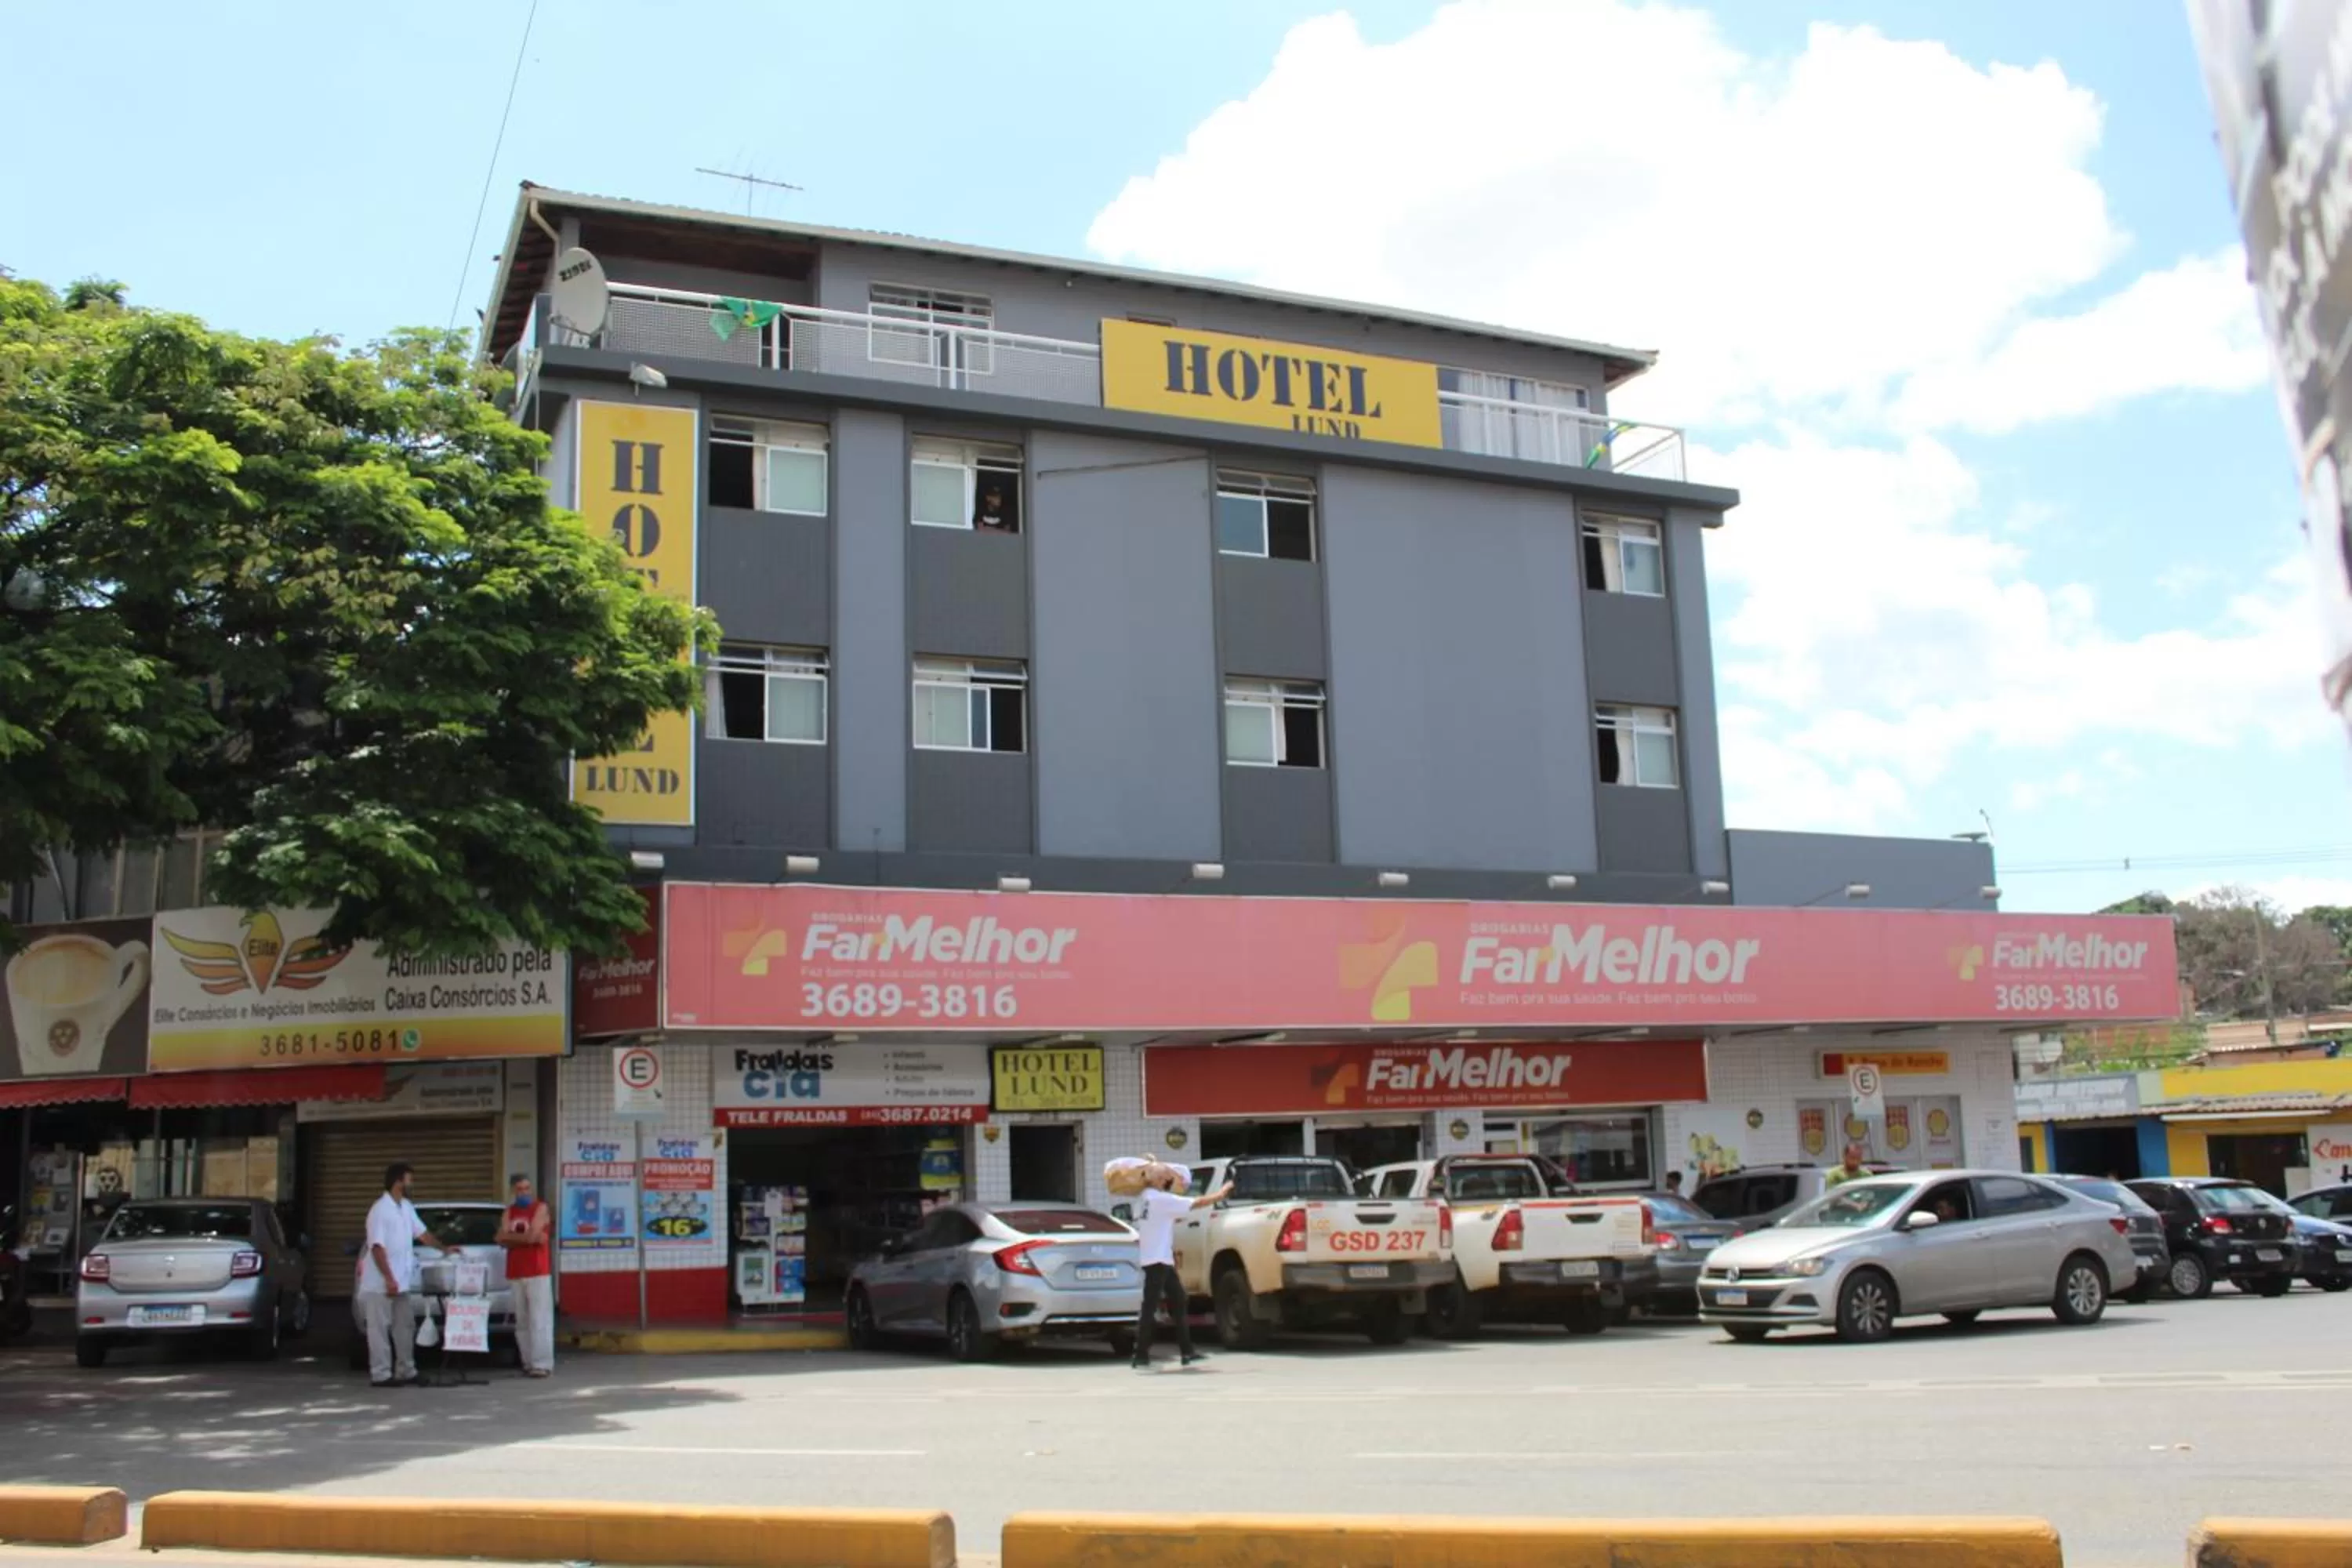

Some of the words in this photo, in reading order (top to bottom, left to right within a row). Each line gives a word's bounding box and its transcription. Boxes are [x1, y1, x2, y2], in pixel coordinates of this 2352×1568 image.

[1163, 340, 1381, 418] HOTEL
[1293, 414, 1360, 439] LUND
[586, 765, 679, 794] LUND
[801, 914, 1077, 964] FarMelhor
[1470, 923, 1549, 935] DROGARIAS
[249, 938, 277, 956] Elite
[1460, 924, 1759, 985] FarMelhor
[1992, 932, 2148, 969] FarMelhor
[387, 946, 507, 978] Administrado
[512, 946, 553, 978] pela
[385, 985, 426, 1011] Caixa
[430, 982, 517, 1009] Consórcios
[521, 981, 553, 1005] S.A.
[800, 982, 1017, 1018] 3689-3816
[1460, 991, 1485, 1004] Faz
[1488, 991, 1519, 1004] bem
[1618, 991, 1640, 1004] Faz
[1994, 984, 2120, 1011] 3689-3816
[260, 1029, 398, 1057] 3681-5081
[630, 1058, 647, 1080] E
[735, 1049, 833, 1072] Fraldas
[1001, 1053, 1098, 1073] HOTEL
[1367, 1047, 1572, 1091] FarMelhor
[1011, 1075, 1088, 1095] LUND
[1860, 1073, 1871, 1090] E
[728, 1111, 768, 1123] TELE
[774, 1109, 848, 1123] FRALDAS
[880, 1106, 972, 1123] 3687.0214
[1330, 1230, 1381, 1251] GSD
[1385, 1230, 1426, 1251] 237
